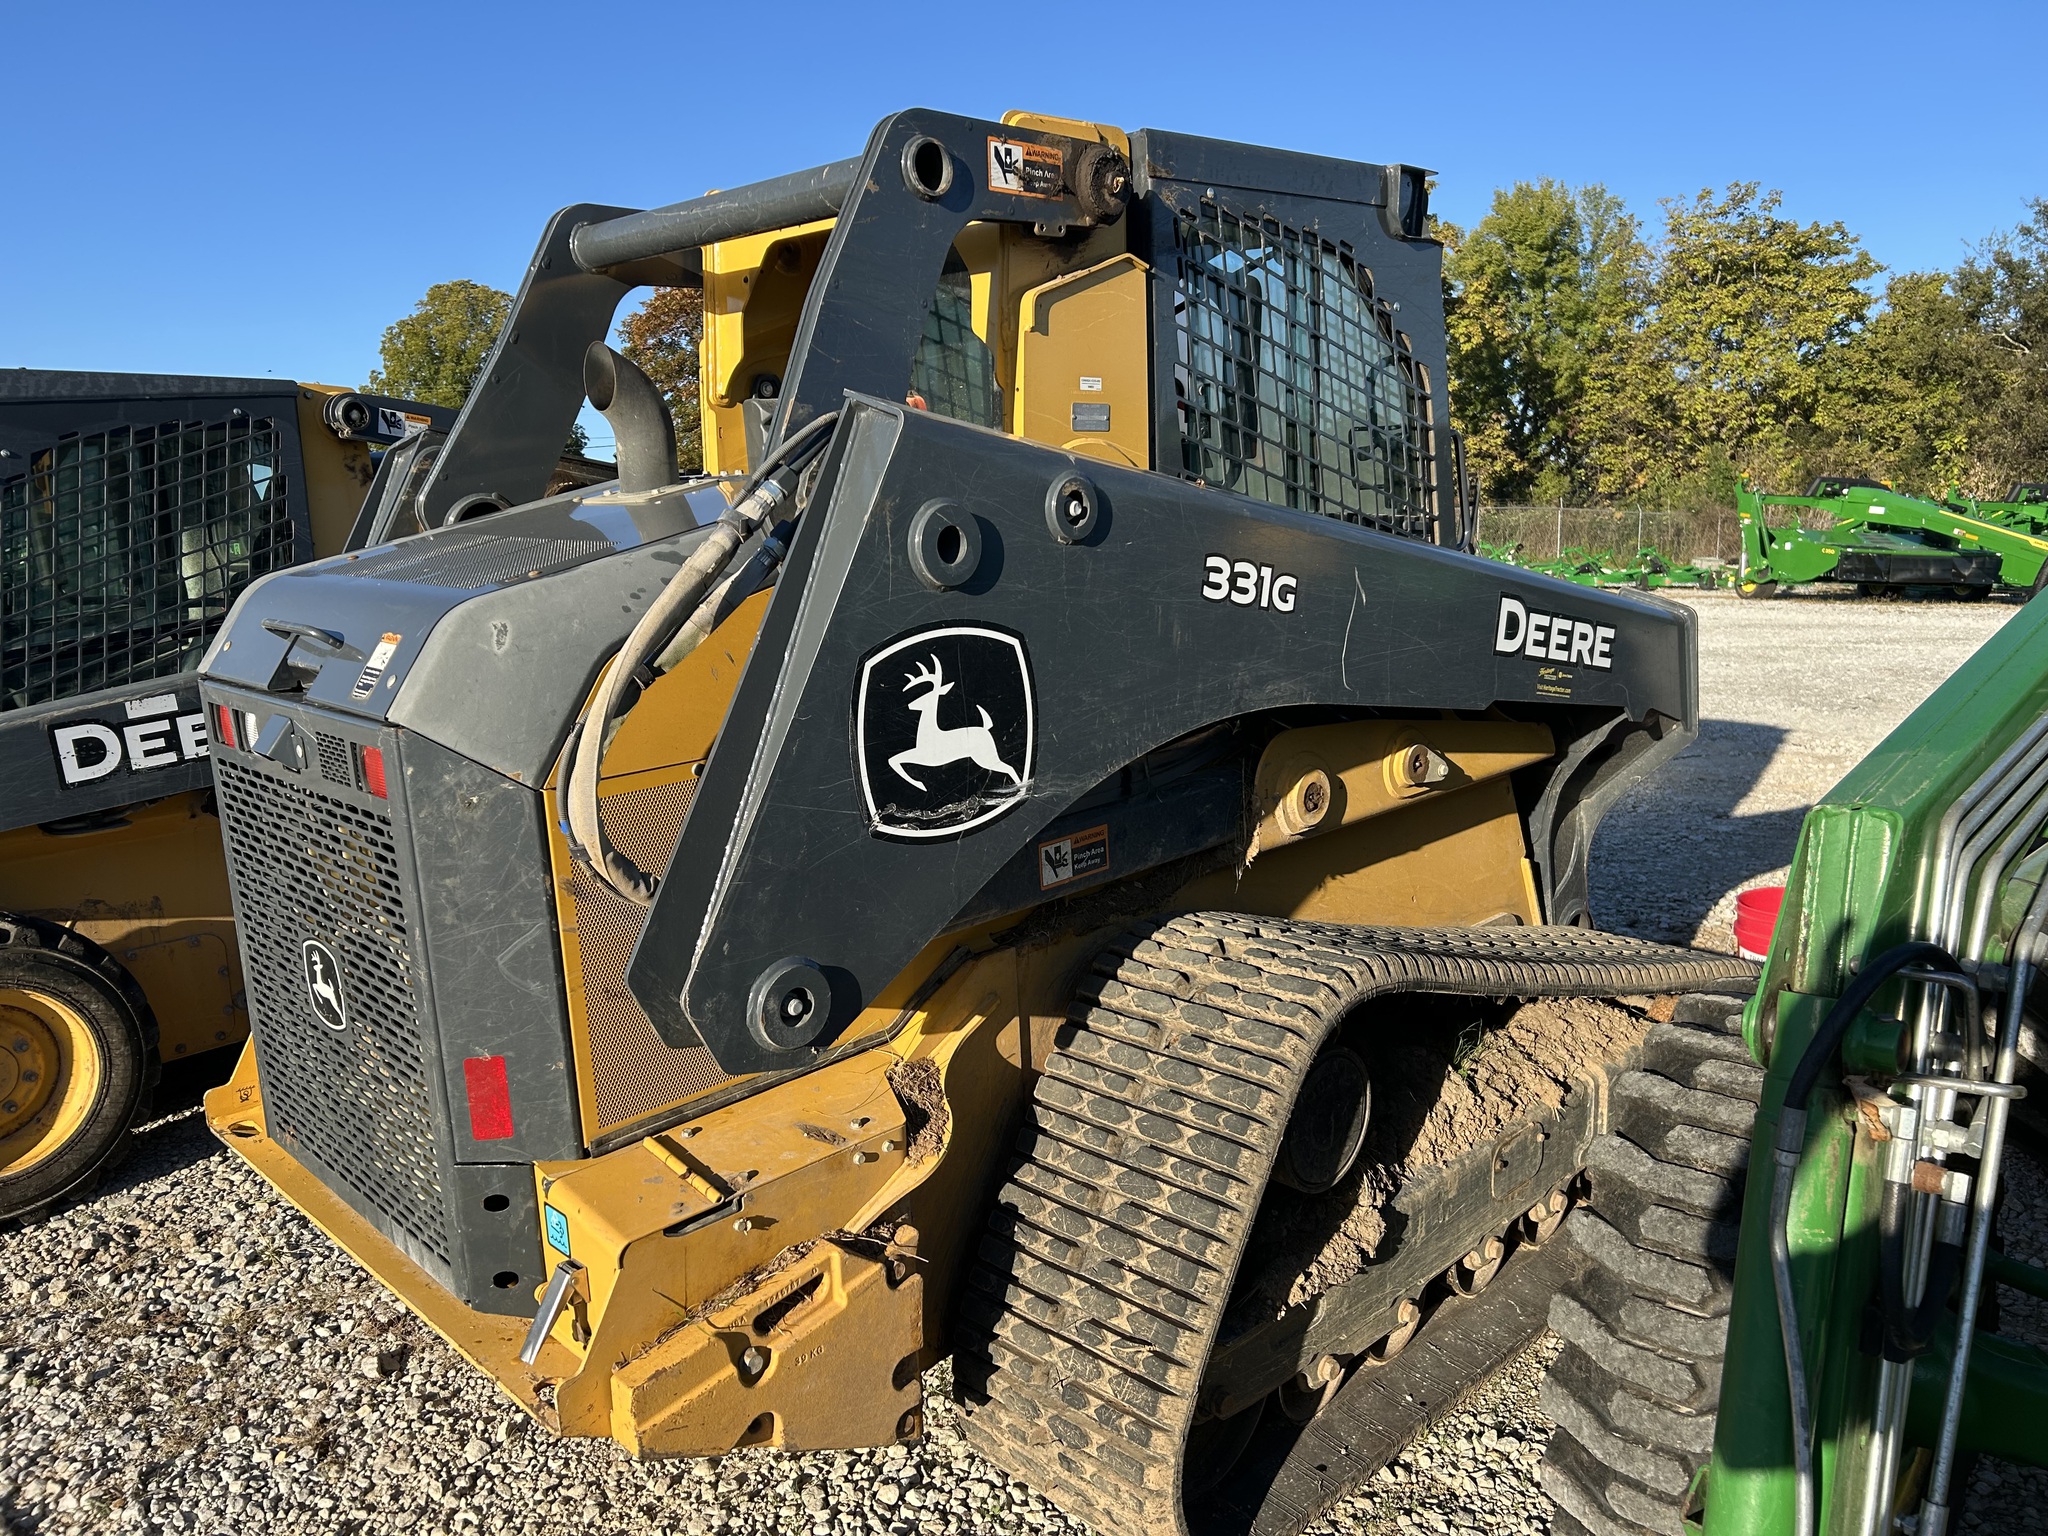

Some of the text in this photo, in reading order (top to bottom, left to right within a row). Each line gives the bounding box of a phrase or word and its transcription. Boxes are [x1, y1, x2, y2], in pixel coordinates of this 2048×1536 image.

[1031, 149, 1059, 161] WARNING
[1025, 166, 1043, 177] Pinch
[1202, 556, 1297, 612] 331G
[1496, 597, 1615, 668] DEERE
[1079, 829, 1104, 842] WARNING
[1073, 846, 1104, 861] Pinch Area
[1074, 857, 1101, 870] Keep Away
[810, 1345, 824, 1359] KG
